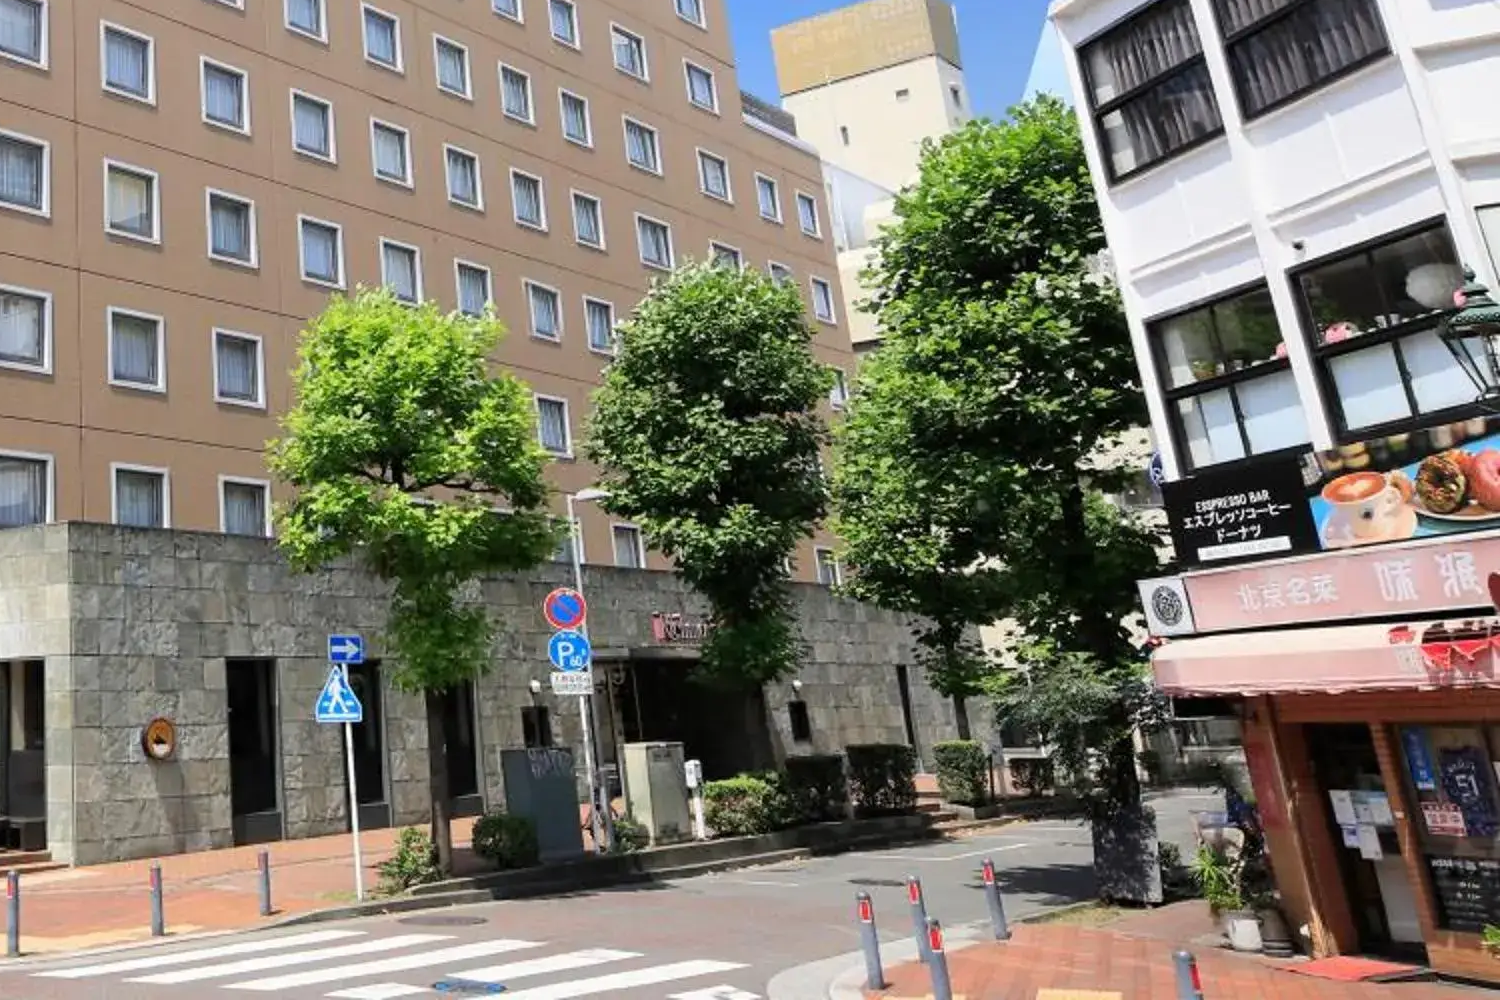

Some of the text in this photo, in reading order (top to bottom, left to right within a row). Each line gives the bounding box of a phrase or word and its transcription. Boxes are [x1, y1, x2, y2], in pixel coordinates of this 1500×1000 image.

[1248, 489, 1270, 503] BAR
[1216, 524, 1262, 543] ドーナツ
[557, 642, 575, 667] P
